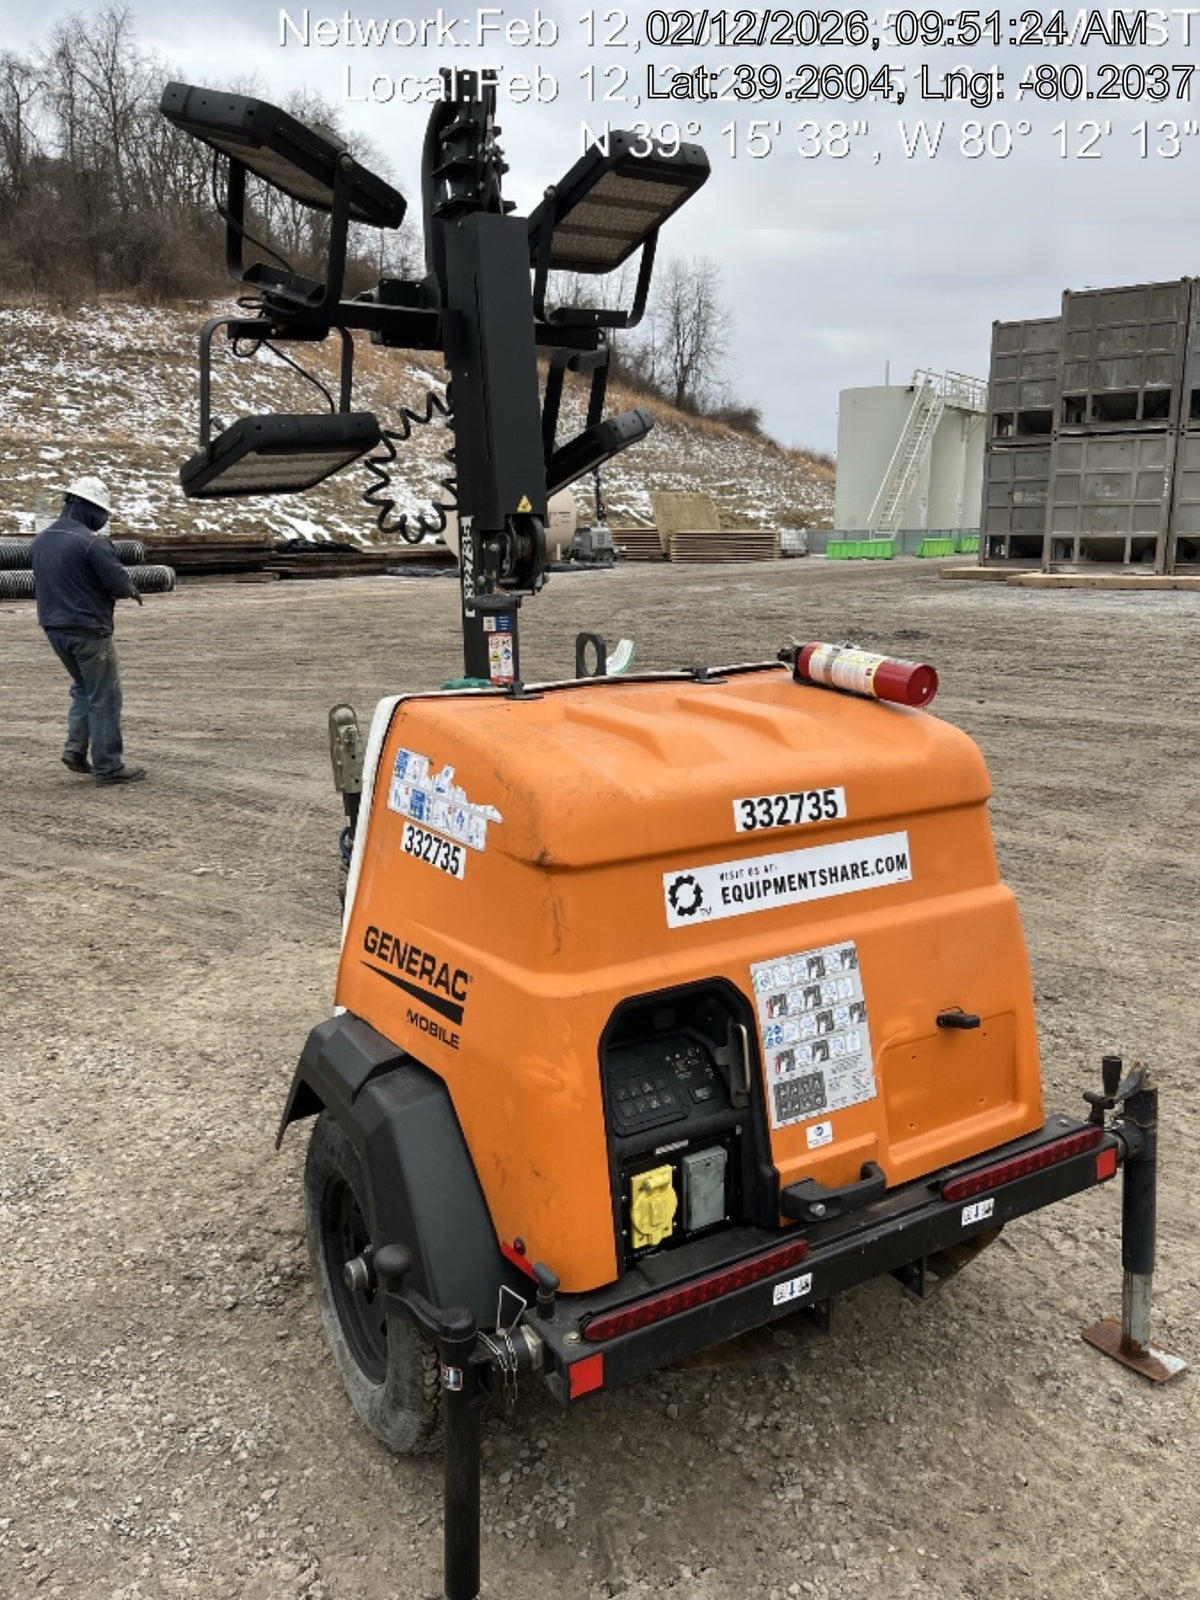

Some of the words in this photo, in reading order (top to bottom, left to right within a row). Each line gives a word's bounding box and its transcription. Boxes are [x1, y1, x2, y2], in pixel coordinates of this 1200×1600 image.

[740, 789, 839, 832] 332735
[404, 824, 462, 876] 332735
[721, 853, 908, 906] EQUIPMENTSHARE.COM
[363, 925, 469, 1002] GENERAC
[406, 1007, 461, 1050] MOBILE
